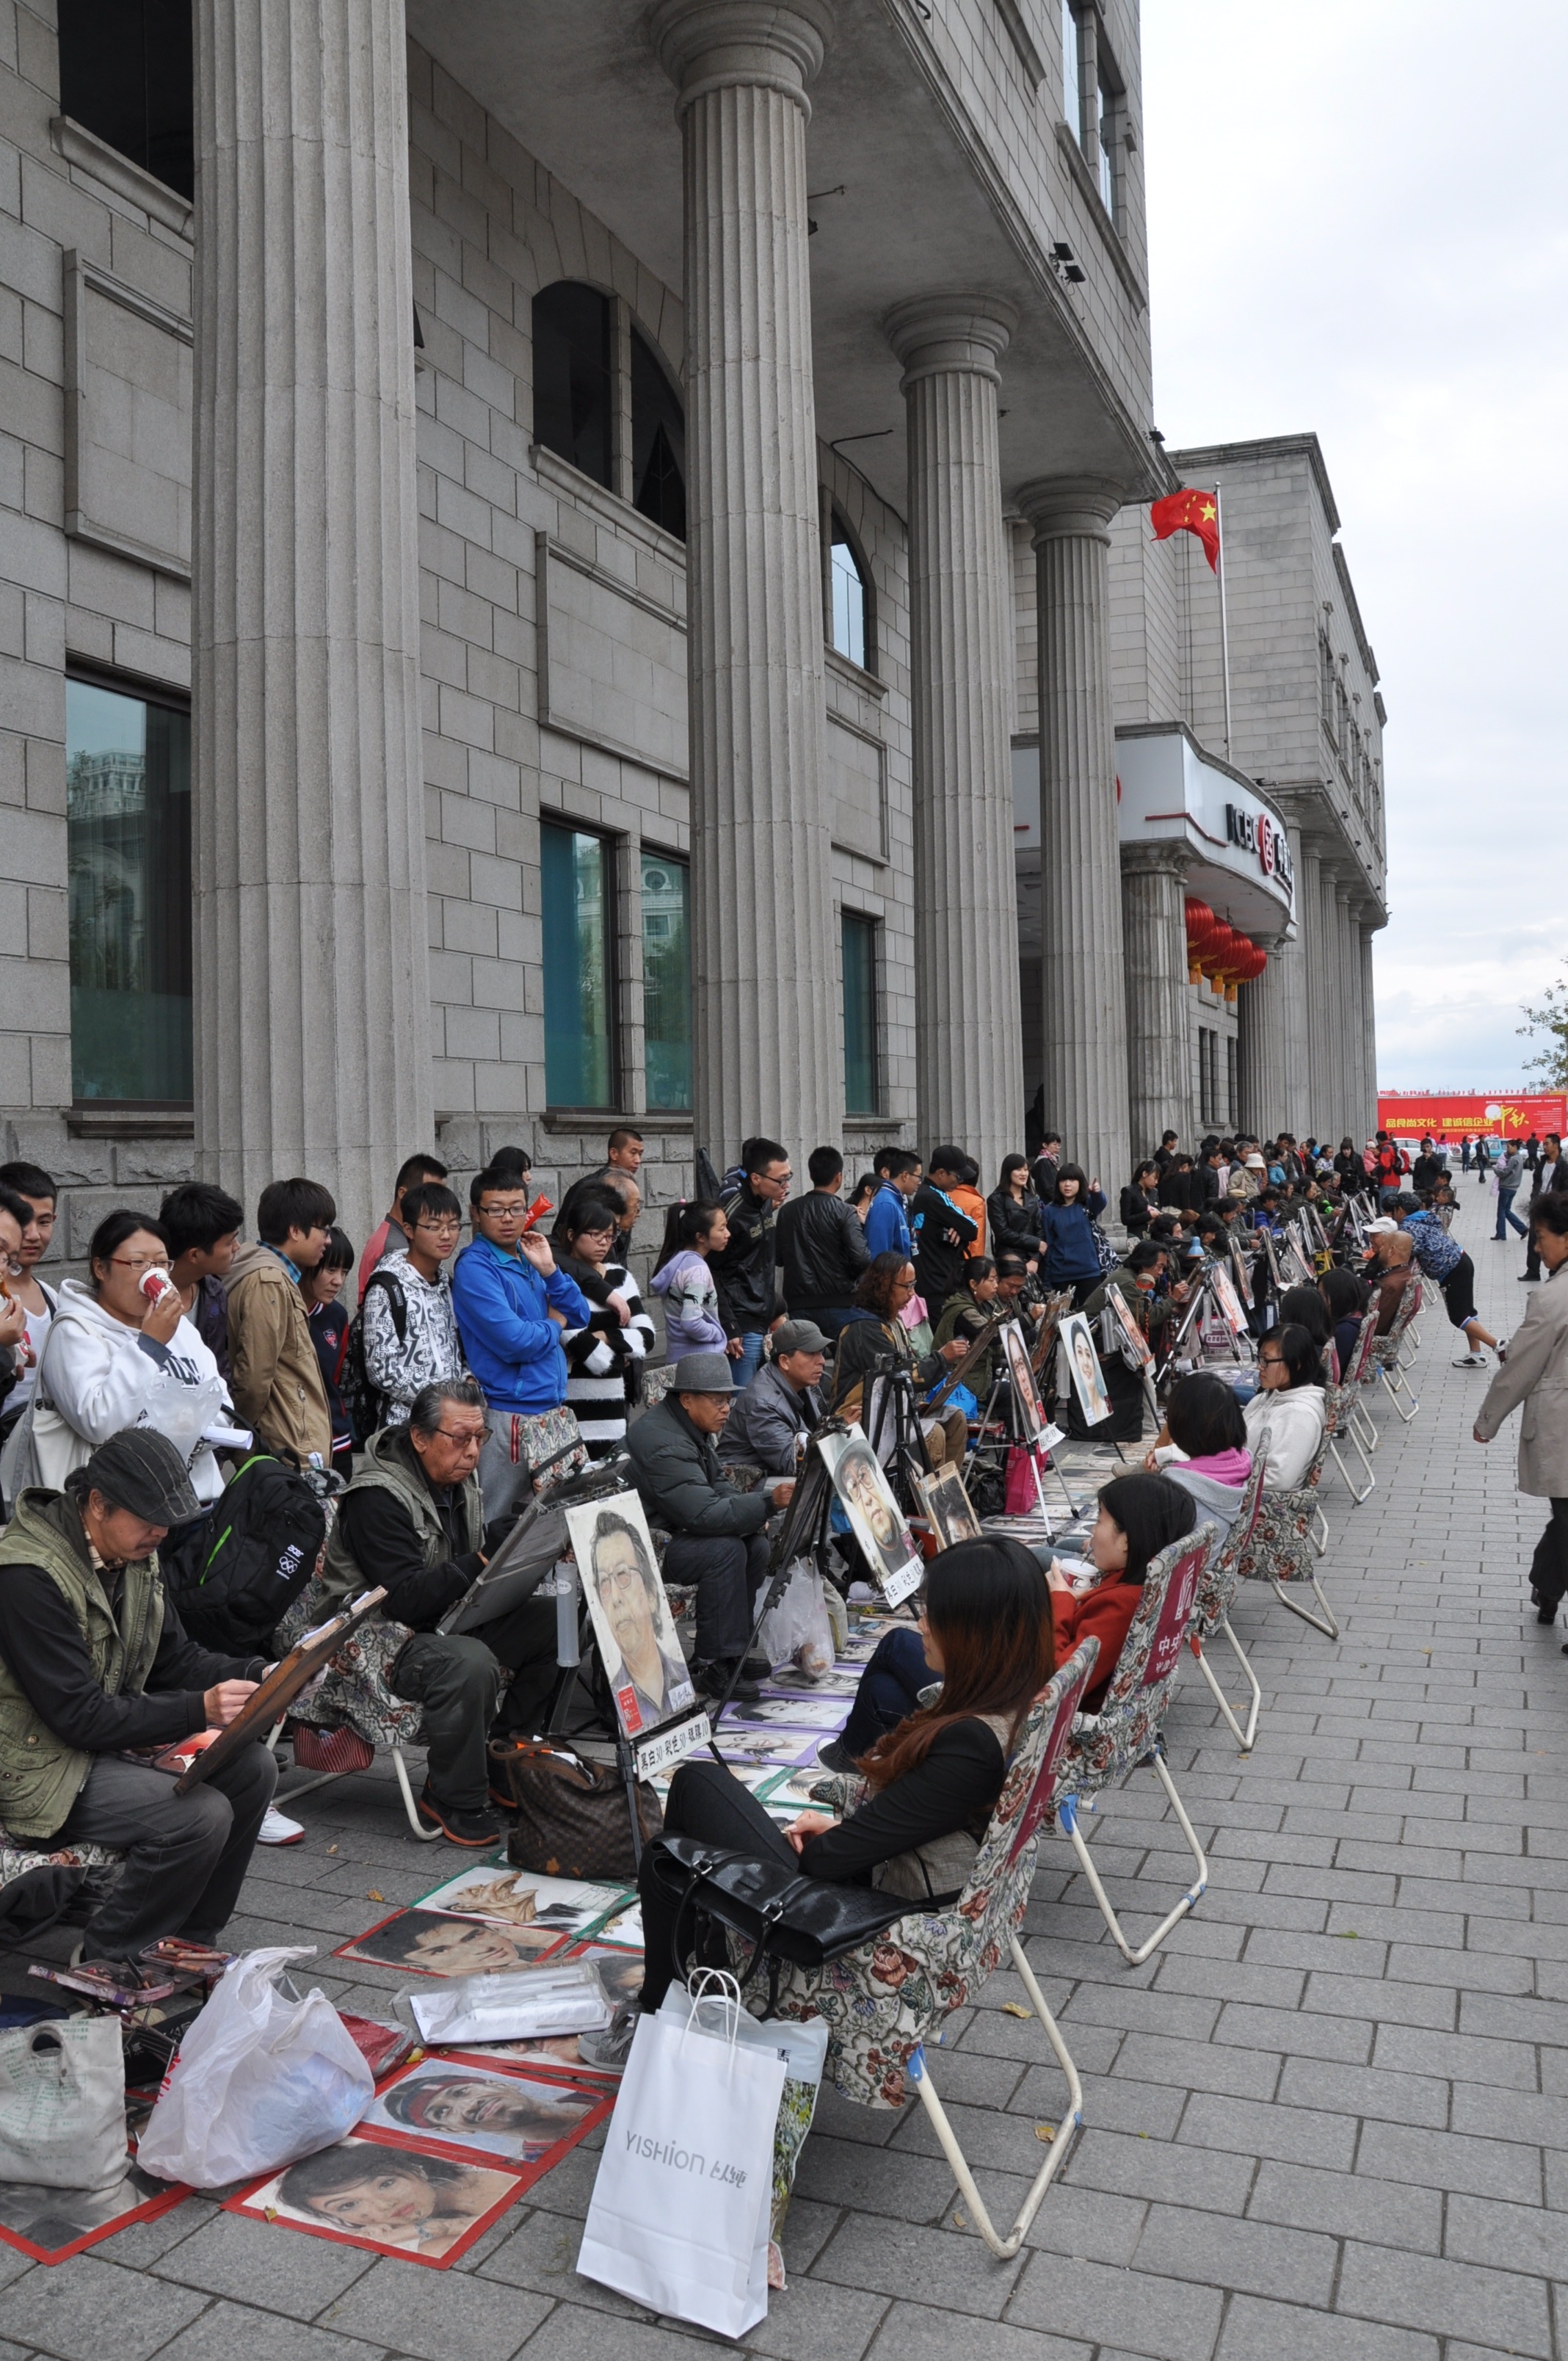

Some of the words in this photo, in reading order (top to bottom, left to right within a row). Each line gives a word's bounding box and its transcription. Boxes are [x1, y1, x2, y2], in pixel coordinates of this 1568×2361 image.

[1225, 803, 1261, 855] ICBC
[1386, 1117, 1437, 1128] 品食尚文化
[1442, 1117, 1495, 1128] 建诚信企业
[287, 1544, 305, 1558] acer
[709, 2160, 748, 2188] 以纯
